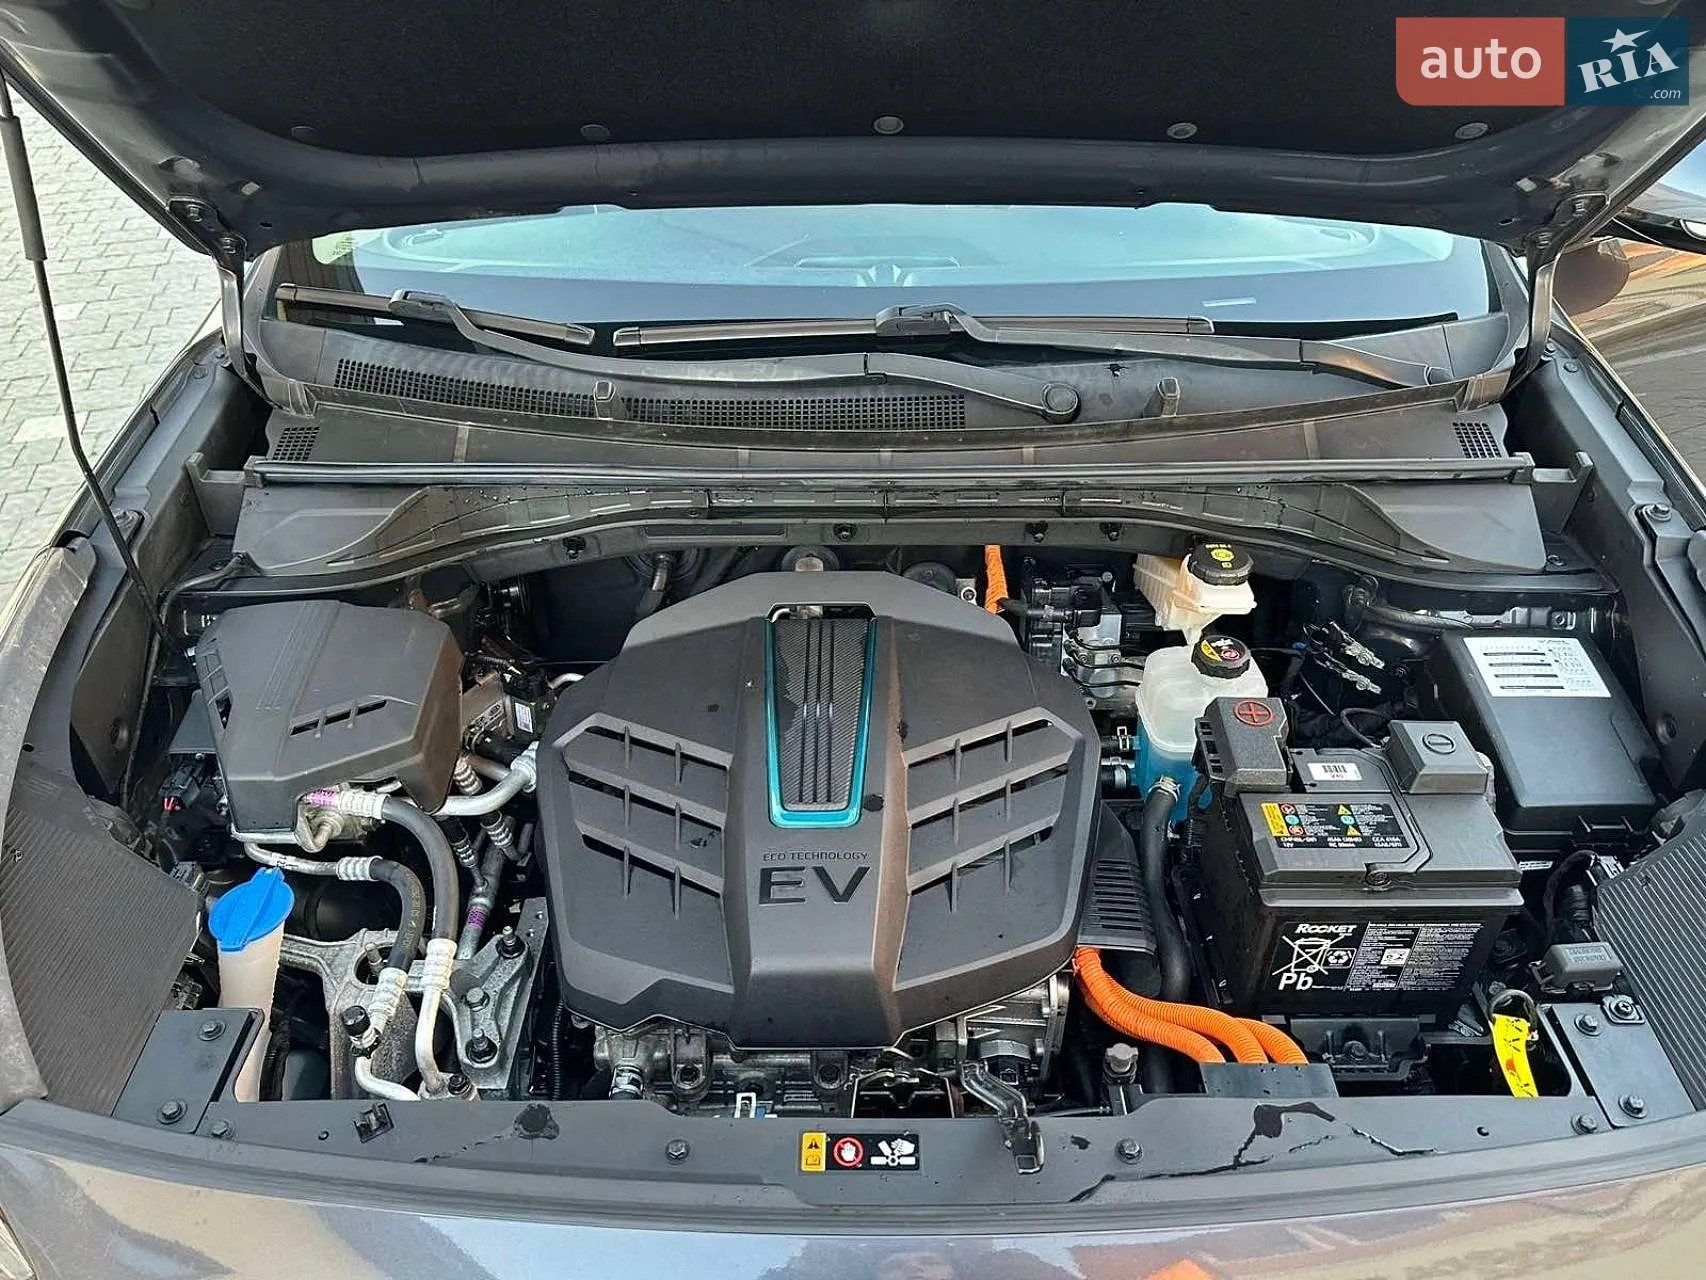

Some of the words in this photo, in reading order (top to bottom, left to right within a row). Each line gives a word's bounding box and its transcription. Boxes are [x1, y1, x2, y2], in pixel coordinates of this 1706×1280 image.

[763, 852, 786, 861] ECO
[789, 851, 868, 861] TECHNOLOGY
[758, 866, 871, 905] EV
[1295, 923, 1358, 934] ROCKET
[1278, 972, 1314, 991] Pb
